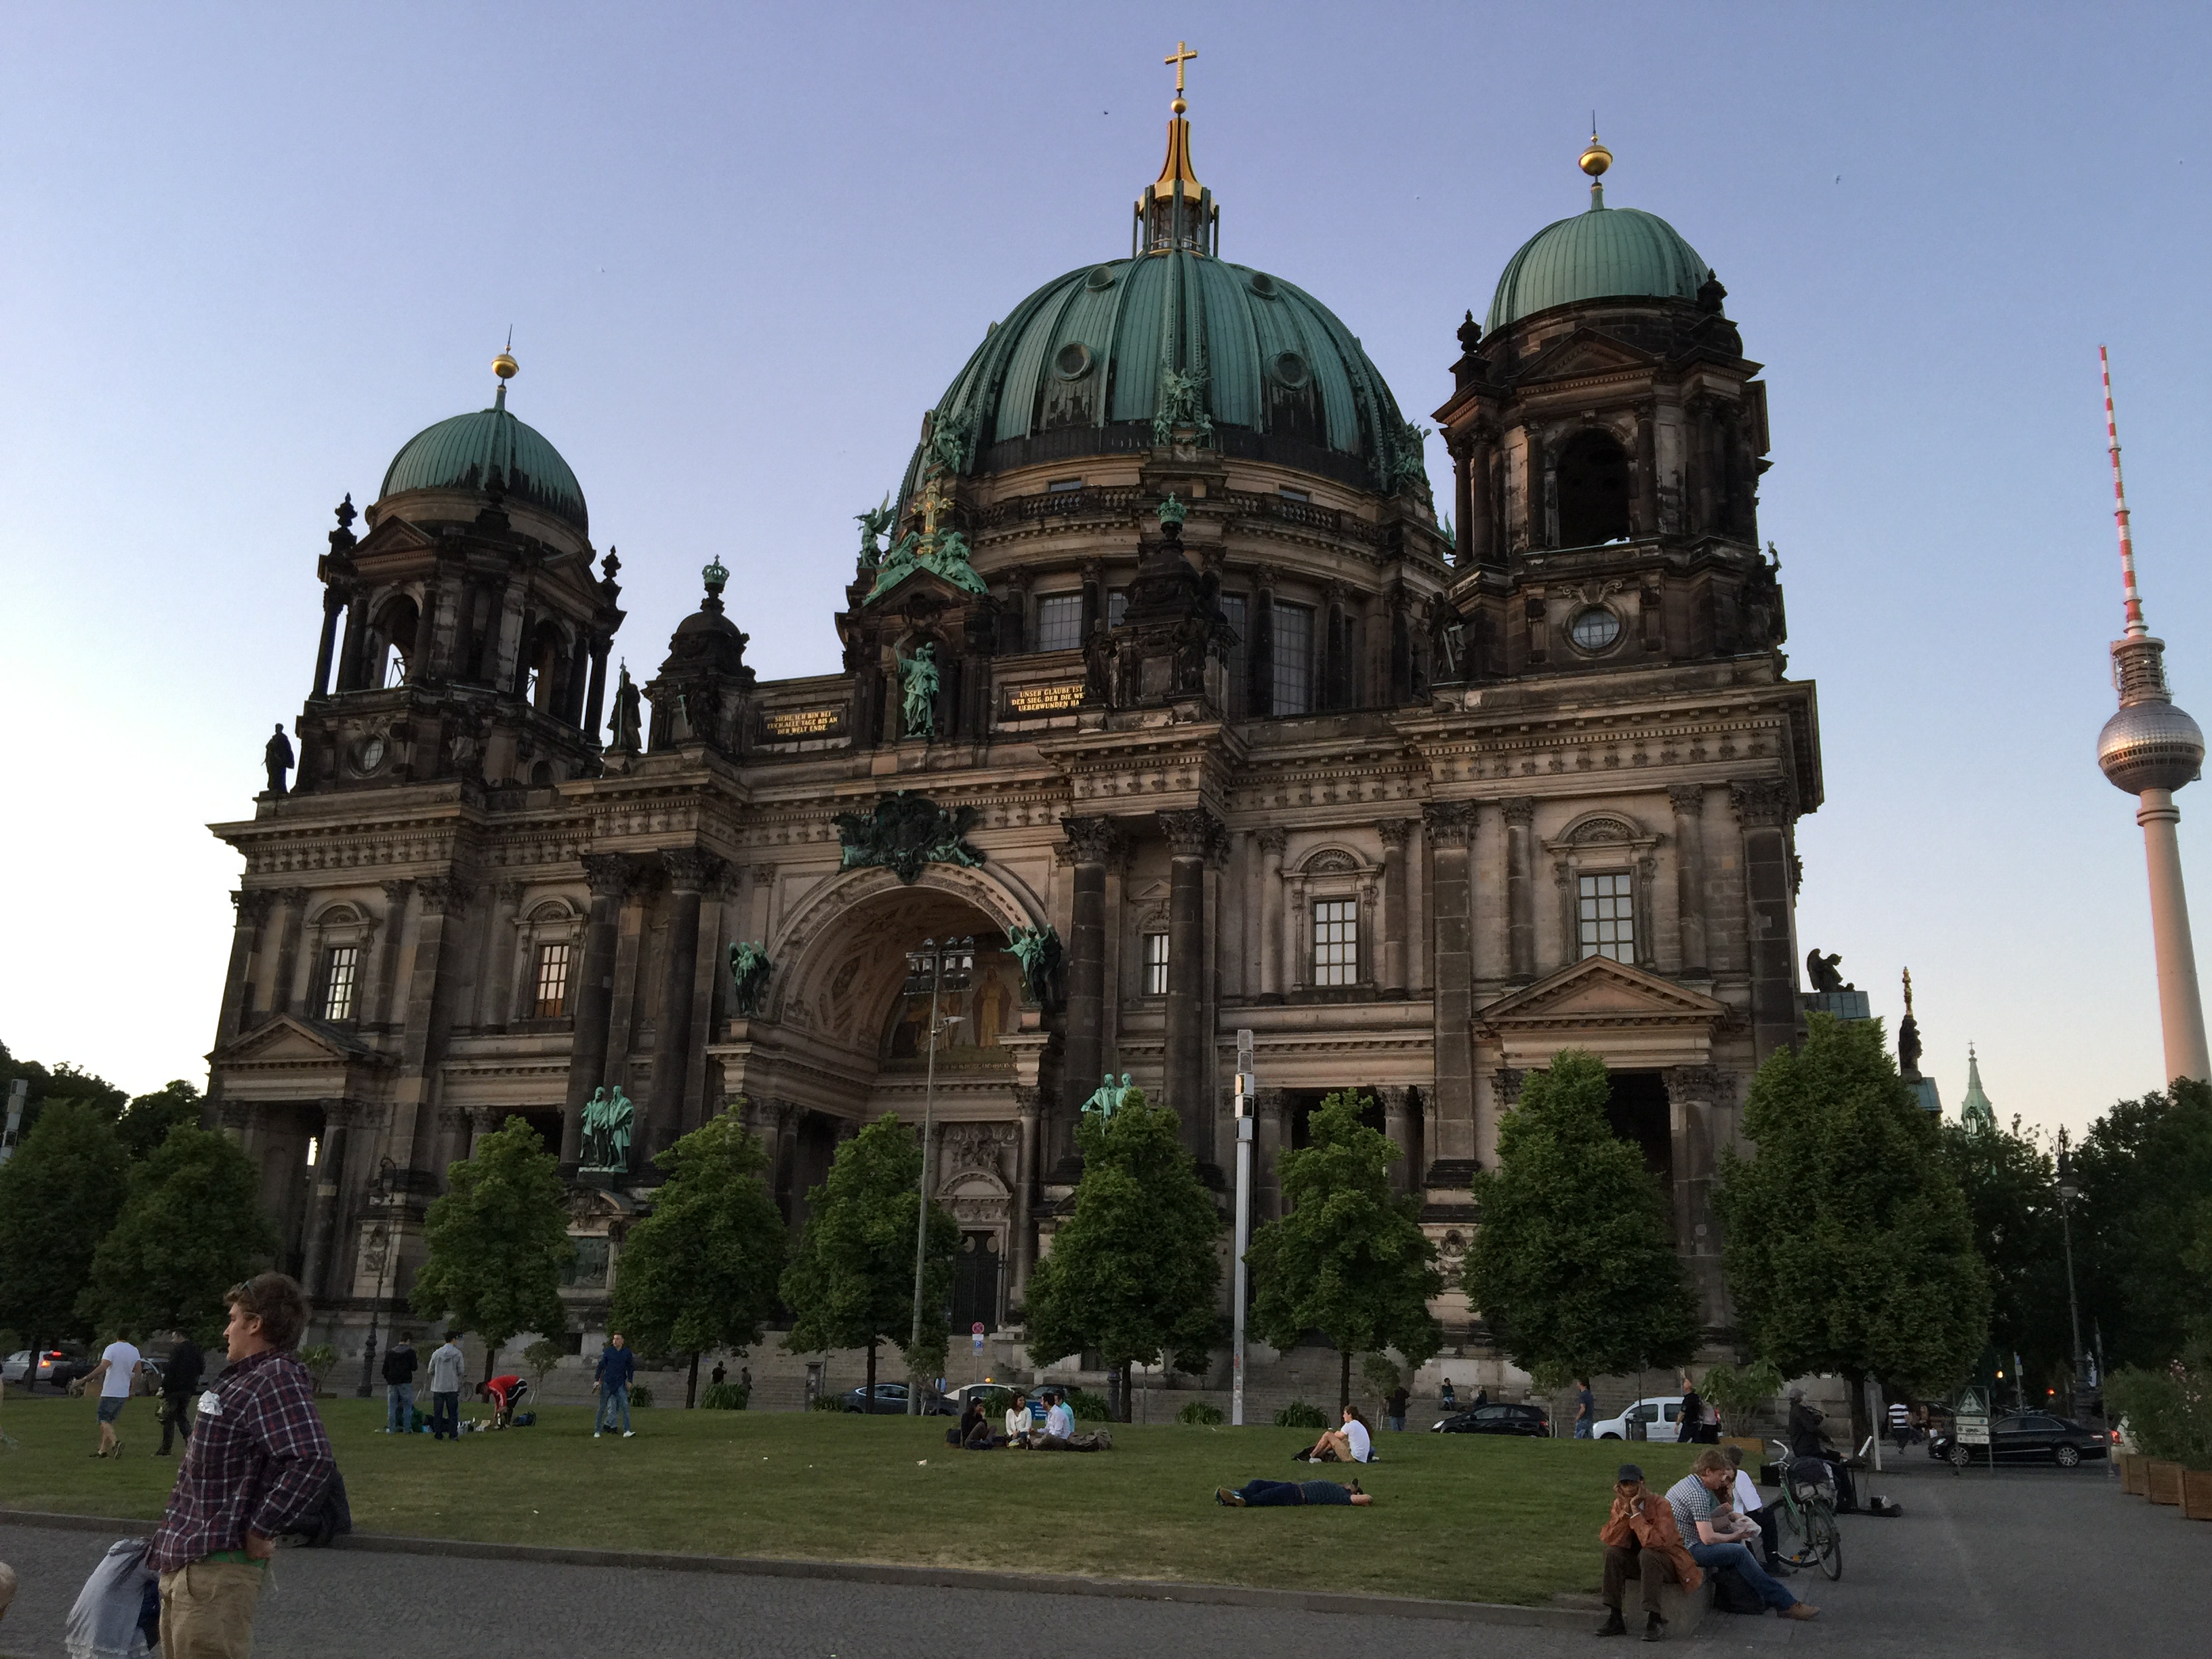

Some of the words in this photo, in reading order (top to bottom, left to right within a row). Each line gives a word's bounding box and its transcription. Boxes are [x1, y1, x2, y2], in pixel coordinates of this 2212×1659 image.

[1044, 687, 1071, 695] GLAUBE
[1019, 701, 1068, 712] UEBERWUNDEN
[792, 726, 808, 734] WELT
[809, 724, 828, 732] ENDE.
